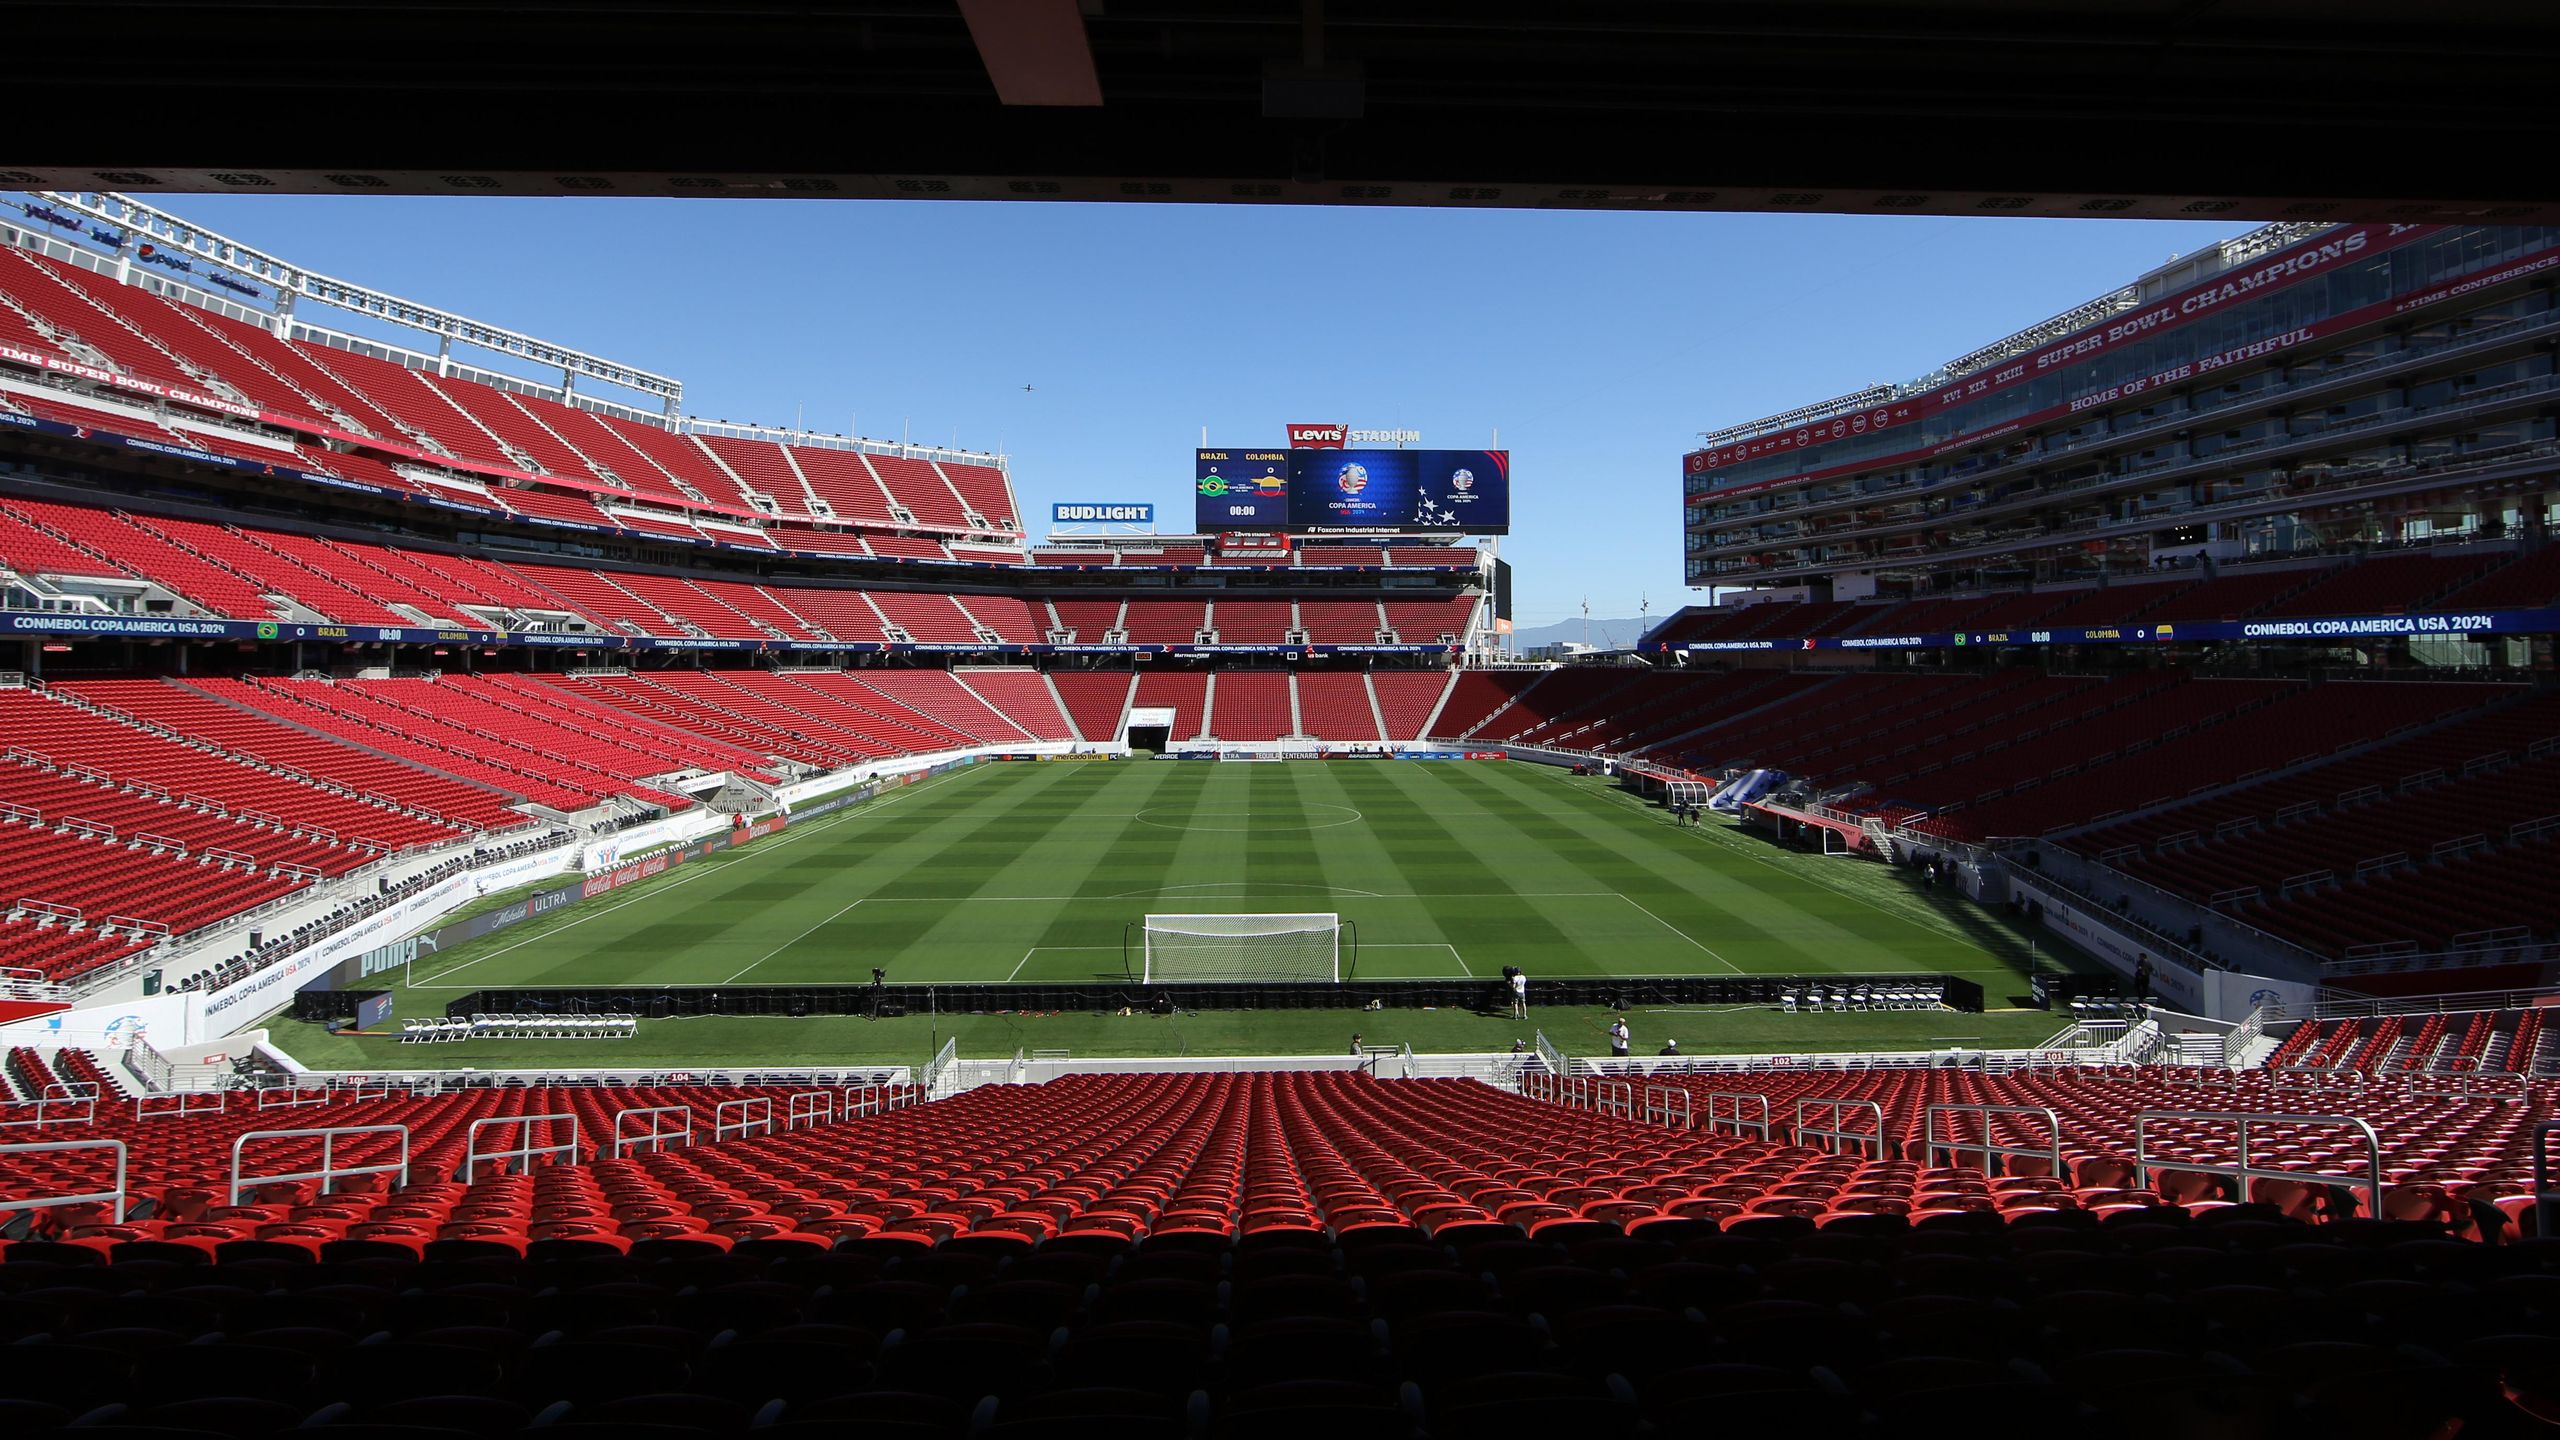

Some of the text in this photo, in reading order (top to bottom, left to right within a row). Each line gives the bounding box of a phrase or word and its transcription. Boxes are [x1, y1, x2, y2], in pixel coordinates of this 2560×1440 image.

[2450, 255, 2559, 295] CONFERENCE
[2037, 231, 2367, 369] SUPER BOWL CHAMPIONS
[2070, 328, 2313, 412] HOME OF THE FAITHFUL
[0, 347, 260, 418] IME SUPER BOWL CHAMPIONS
[1352, 431, 1420, 442] STADIUM
[1982, 424, 2019, 439] CHAMPIONS
[1245, 453, 1285, 461] COLOMBIA
[1057, 506, 1148, 520] BUD LIGHT
[1230, 506, 1255, 516] 00:00
[13, 617, 225, 634] CONMEBOL COPA AMERICA USA 2024
[2244, 615, 2492, 636] CONMEBOL COPA AMERICA USA 2024
[296, 627, 305, 637] 0
[317, 627, 348, 637] BRAZIL
[379, 628, 402, 640] 00:00
[438, 631, 469, 641] COLOMBIA
[1988, 634, 2009, 642] BRAZIL
[2032, 631, 2050, 642] 00:00
[2085, 629, 2120, 639] COLOMBIA
[524, 635, 551, 643] CONMEBOL
[564, 636, 584, 644] AMERICA
[1841, 639, 1866, 647] CONMEBOL
[1876, 638, 1899, 646] AMERICA
[1282, 752, 1318, 760] CENTENARIO
[615, 866, 640, 884] Coca-Cola
[584, 875, 611, 894] Coca-Cola
[492, 891, 567, 929] Michelob ULTRA
[322, 936, 350, 957] CONMEBOL
[350, 929, 364, 942] COPA
[364, 919, 384, 938] AMERICA
[205, 993, 238, 1017] NMEBOL
[238, 986, 257, 1001] COPA
[257, 970, 285, 990] AMERICA
[285, 964, 297, 977] USA
[348, 1076, 366, 1085] 105
